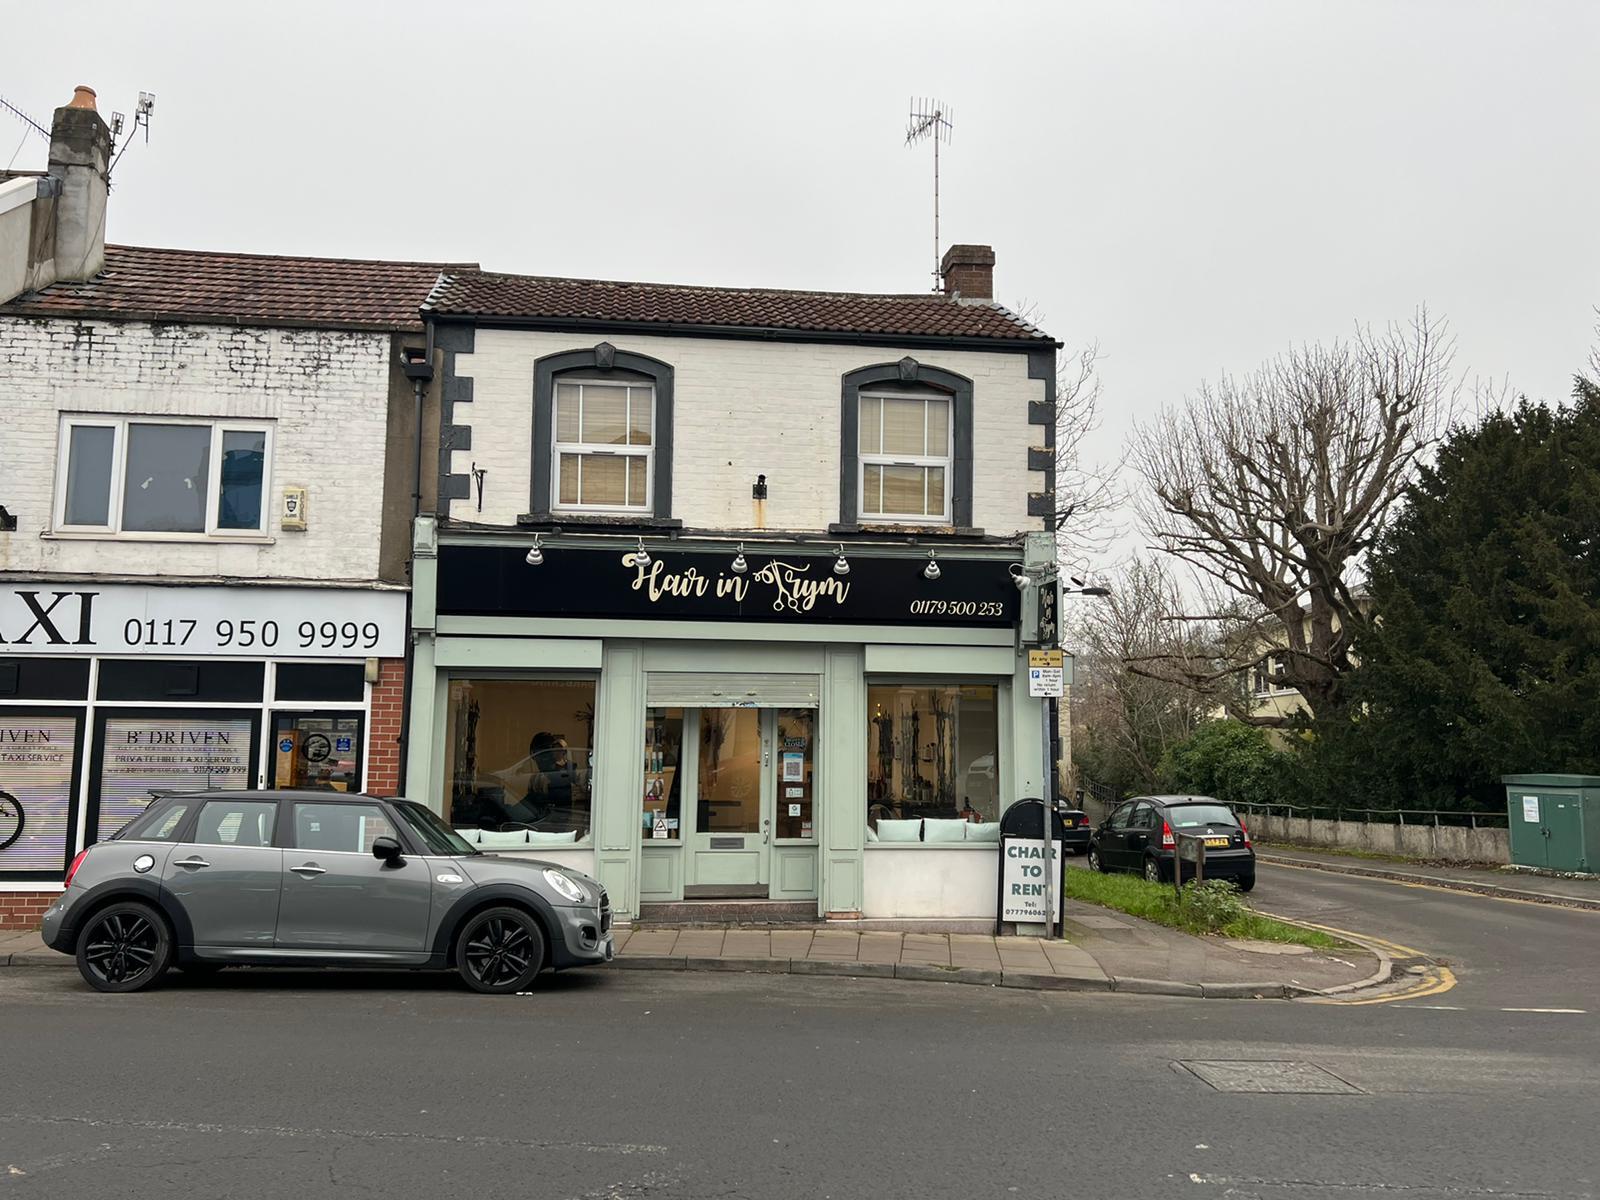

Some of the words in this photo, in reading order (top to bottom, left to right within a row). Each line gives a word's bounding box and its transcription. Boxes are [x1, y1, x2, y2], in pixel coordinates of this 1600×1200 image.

[621, 553, 709, 602] Hair
[717, 572, 749, 602] in
[752, 559, 850, 613] Trym
[910, 600, 947, 614] 01179
[947, 601, 977, 616] 500
[978, 602, 1003, 616] 253
[0, 591, 100, 645] XI
[123, 618, 197, 646] 0117
[216, 619, 279, 647] 950
[298, 621, 380, 648] 9999
[149, 731, 230, 745] DRIVEN
[115, 755, 154, 763] PRIVATE
[204, 756, 241, 764] SERVICE
[1021, 865, 1042, 877] TO
[1011, 883, 1046, 896] REN
